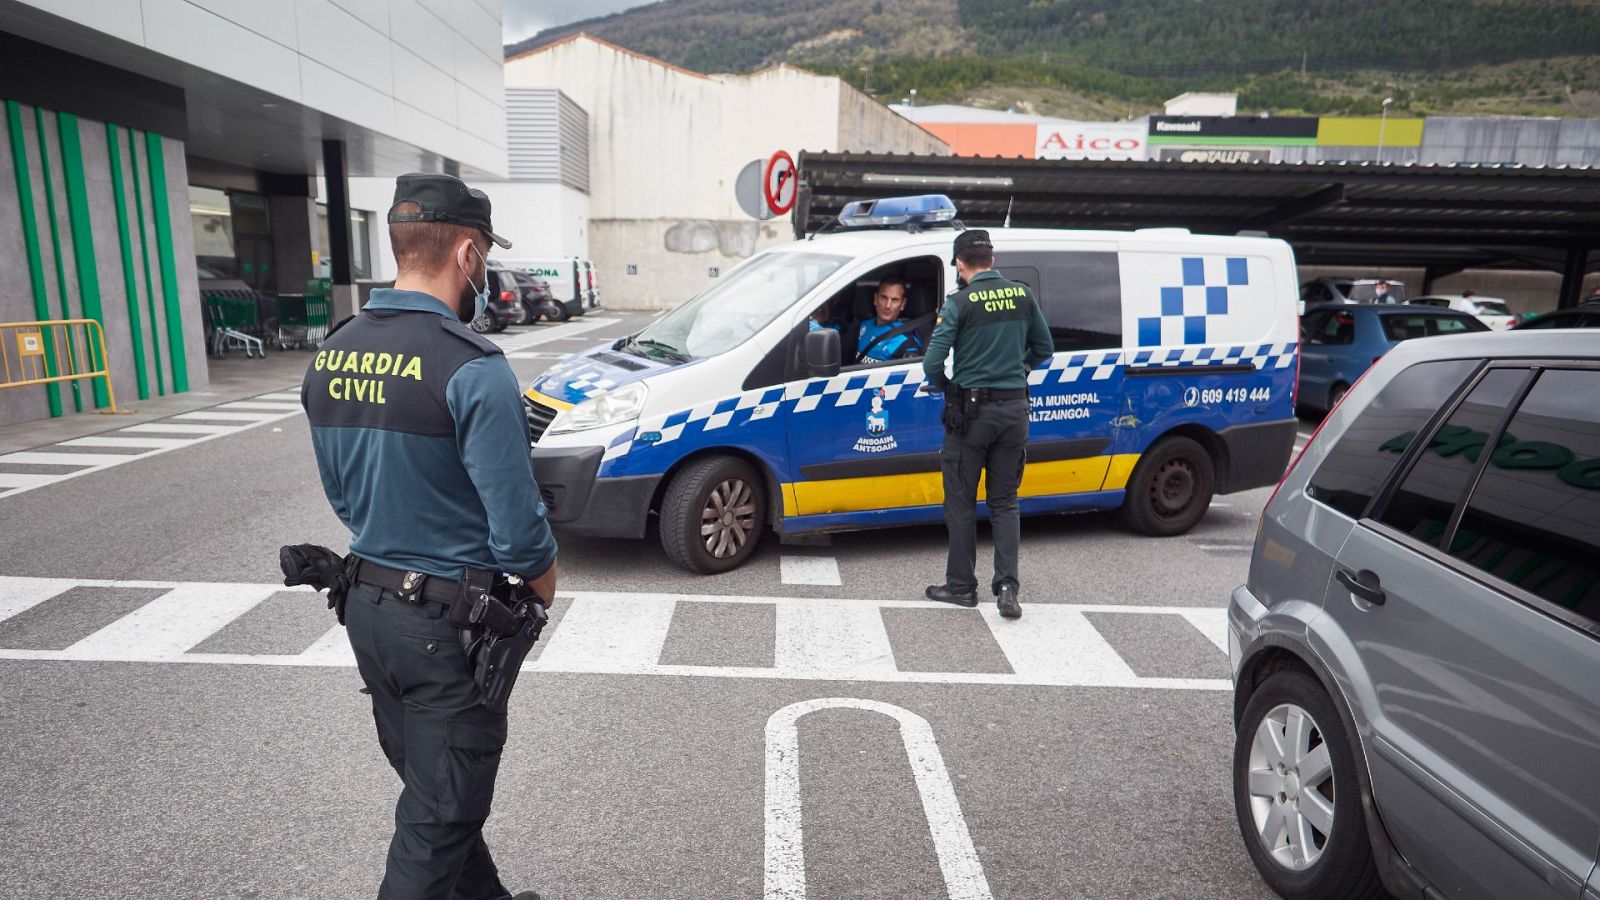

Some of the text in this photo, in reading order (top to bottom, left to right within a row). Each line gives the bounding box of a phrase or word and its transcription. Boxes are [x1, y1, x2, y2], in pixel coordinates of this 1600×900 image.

[1042, 132, 1140, 150] Aico
[968, 287, 1026, 302] GUARDIA
[984, 299, 1016, 312] CIVIL
[314, 350, 422, 381] GUARDIA
[328, 377, 386, 404] CIVIL
[1201, 387, 1270, 404] 609 419 444
[1045, 392, 1100, 407] MUNICIPAL
[852, 441, 898, 453] ANTSOAIN
[857, 435, 894, 446] ANSOAIN
